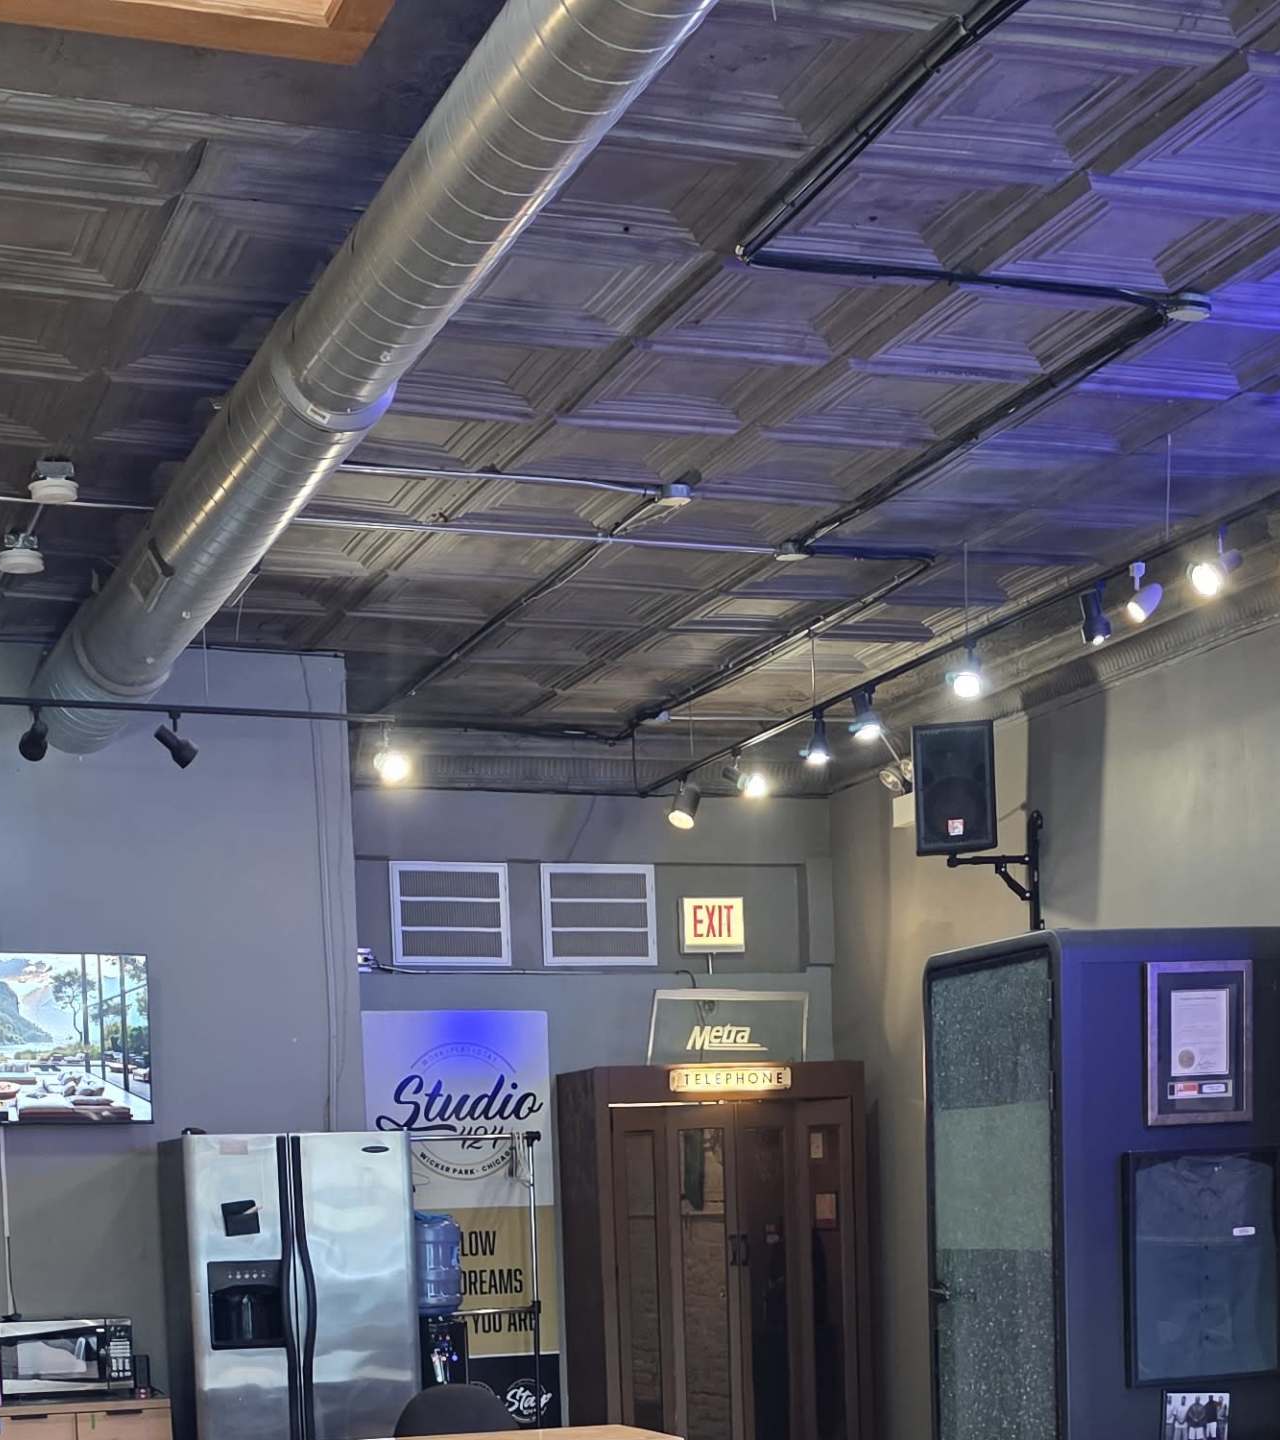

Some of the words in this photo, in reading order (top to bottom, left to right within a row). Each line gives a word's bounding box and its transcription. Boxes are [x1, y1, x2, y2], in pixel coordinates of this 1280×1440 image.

[692, 904, 734, 938] EXIT
[686, 1023, 752, 1050] Metra
[684, 1071, 783, 1086] TELEPHONE
[375, 1074, 544, 1132] Studio
[420, 1151, 451, 1173] WICKER
[452, 1167, 475, 1175] PARK
[481, 1150, 511, 1172] CHICAG
[460, 1230, 496, 1256] LOW
[461, 1268, 523, 1295] DREAMS
[472, 1312, 502, 1334] YOU
